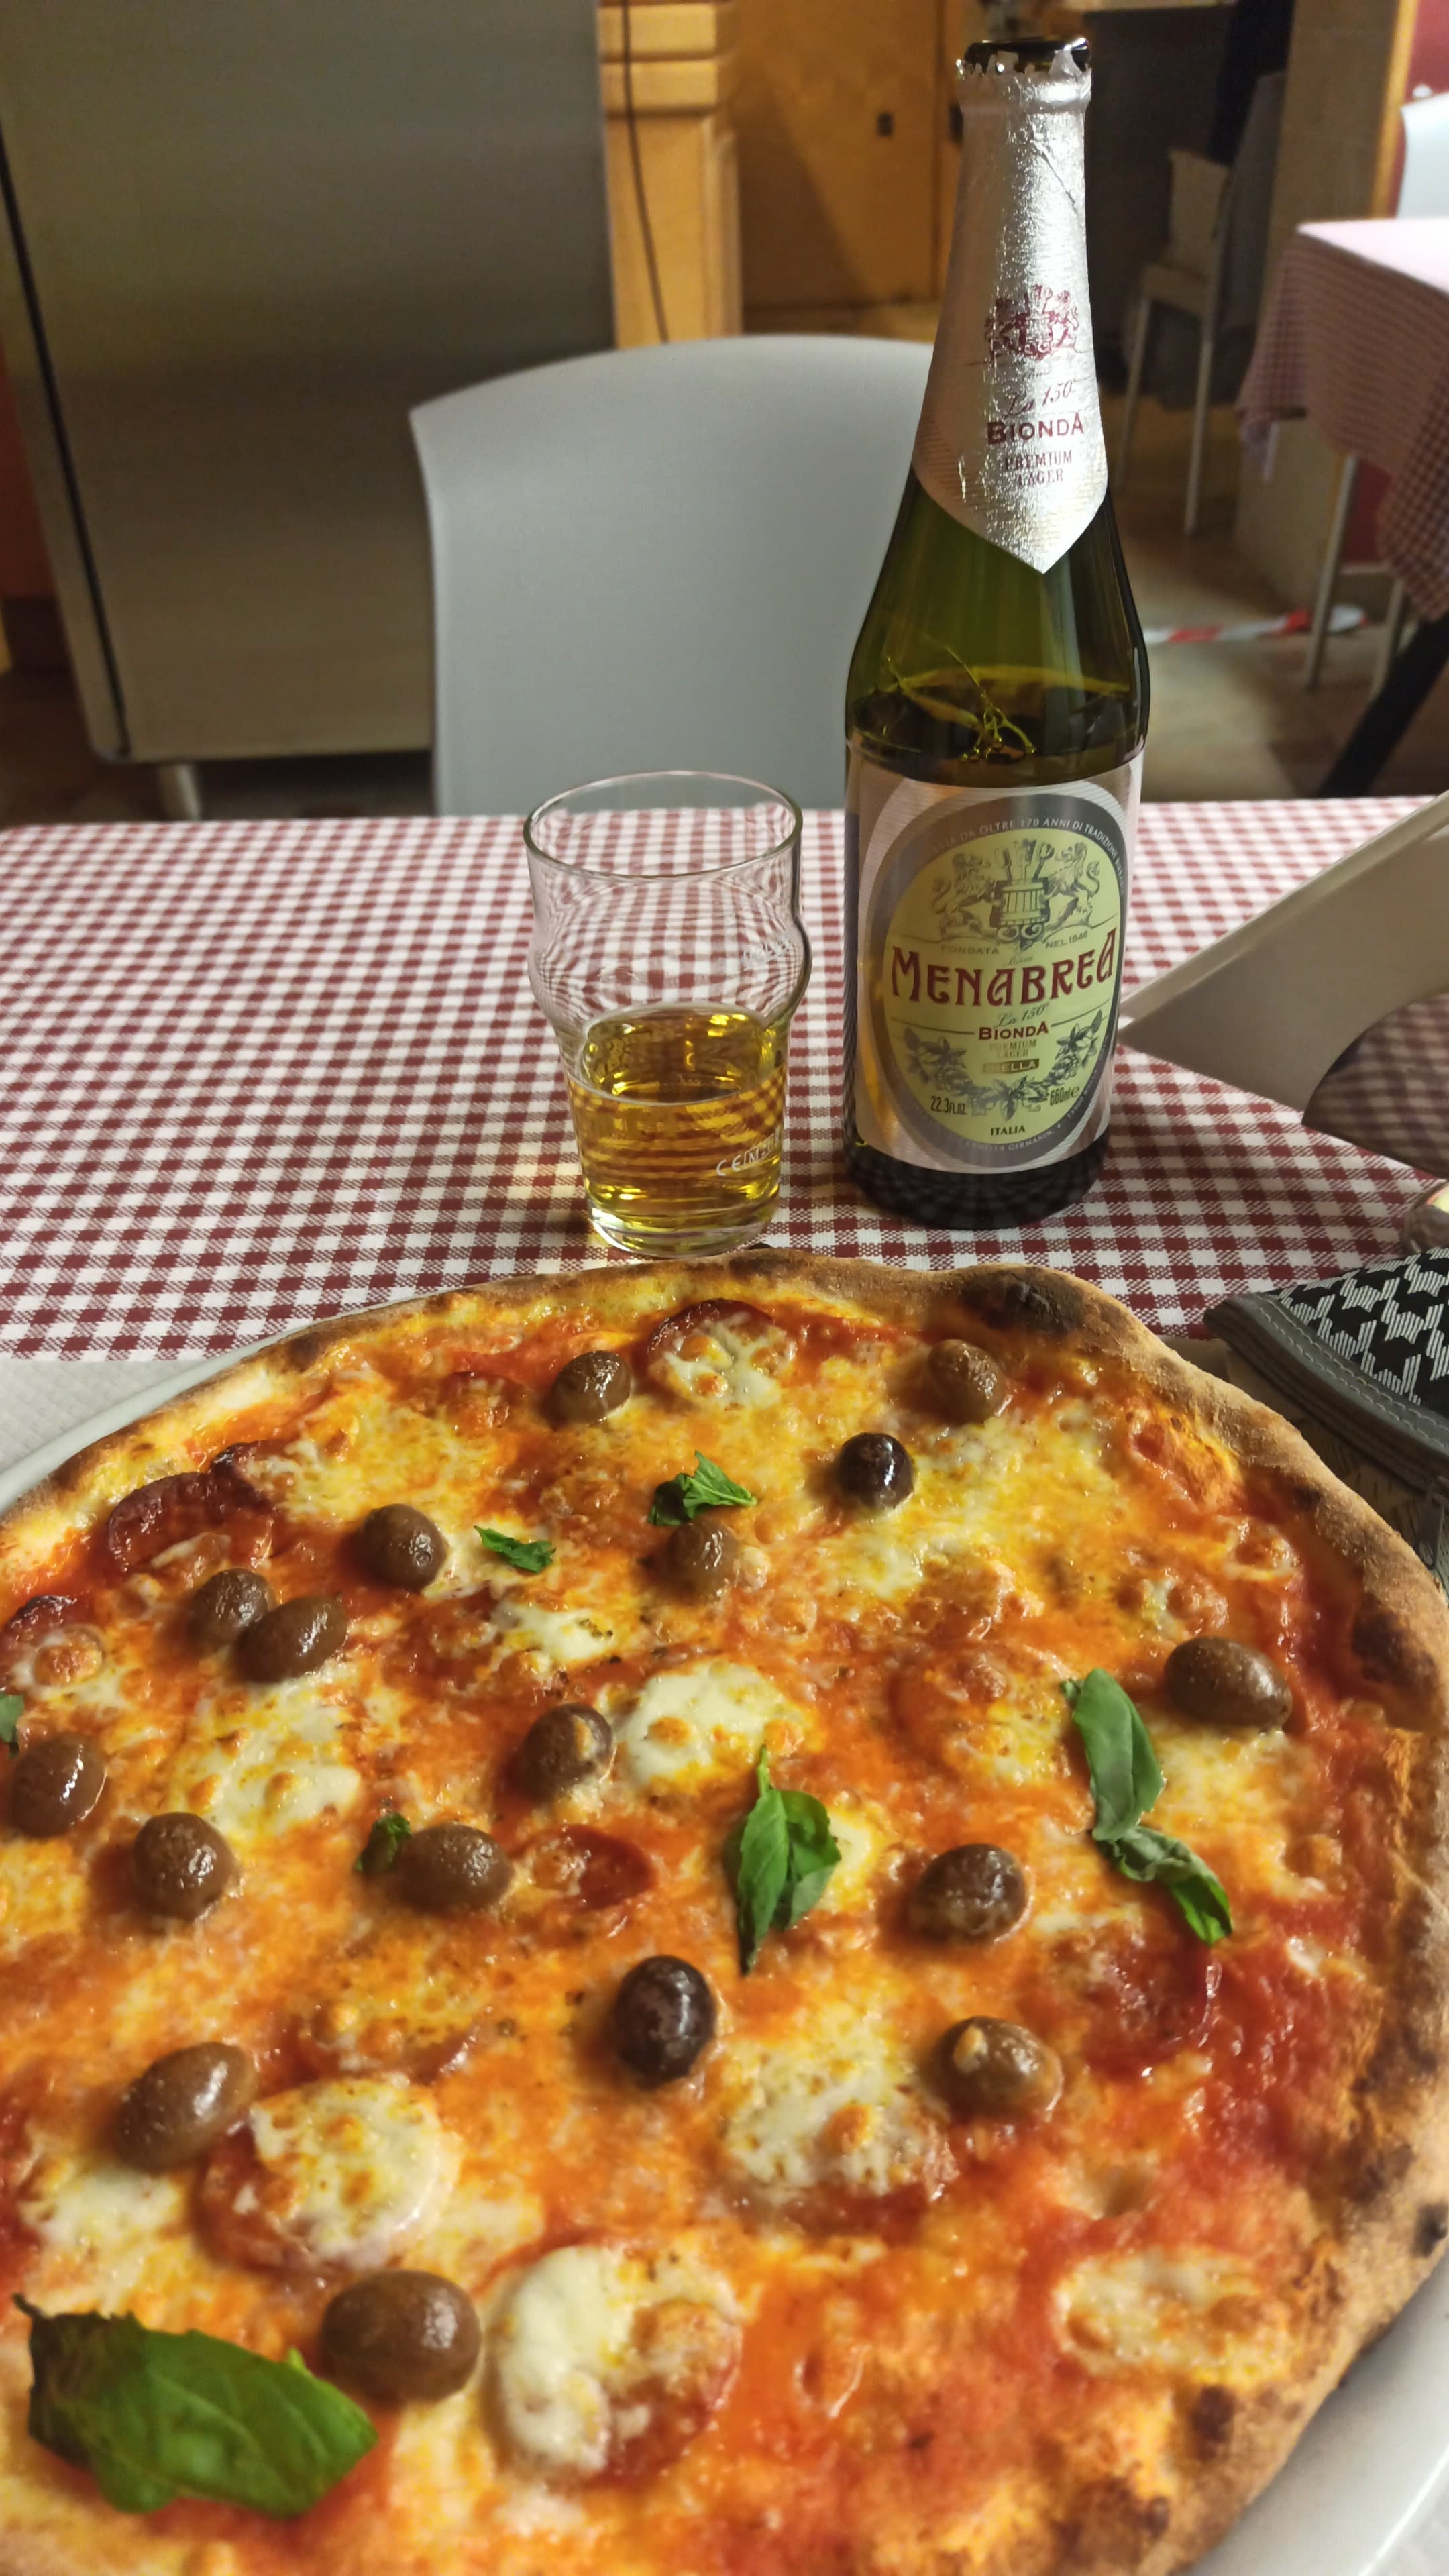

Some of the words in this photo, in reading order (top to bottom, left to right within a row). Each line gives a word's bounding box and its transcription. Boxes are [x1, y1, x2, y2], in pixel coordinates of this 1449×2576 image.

[987, 413, 1084, 445] BIONDA
[1006, 449, 1073, 471] PREMIUM
[1016, 468, 1063, 488] LAGER
[1020, 818, 1040, 828] 170
[1042, 818, 1071, 828] ANNI
[1072, 820, 1083, 832] DI
[941, 944, 1000, 955] FONDATA
[1045, 939, 1067, 949] NEL
[892, 927, 1117, 1006] MENABREA
[979, 1020, 1049, 1040] BIONDA
[990, 1124, 1026, 1136] ITALIA
